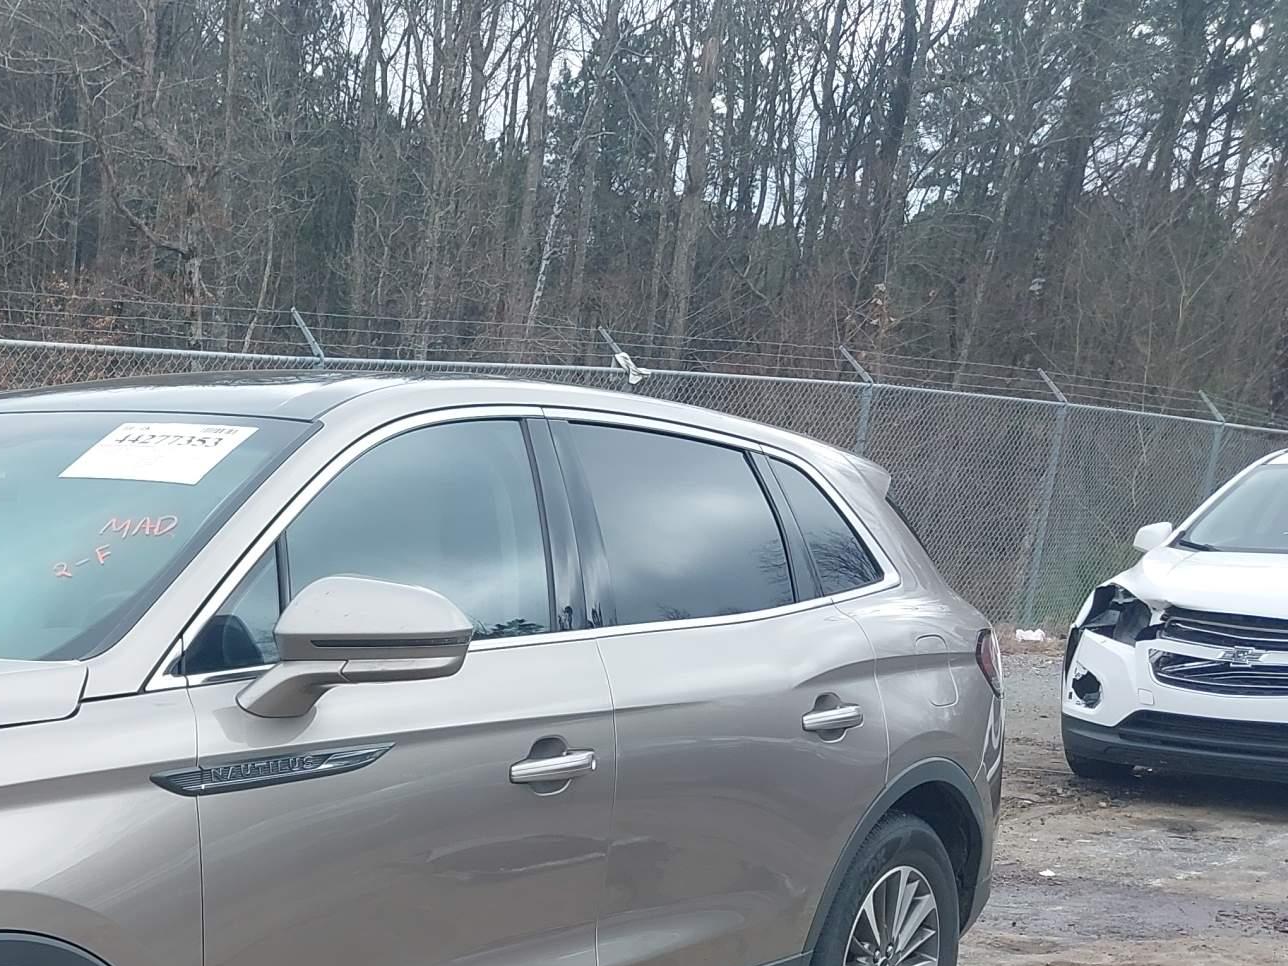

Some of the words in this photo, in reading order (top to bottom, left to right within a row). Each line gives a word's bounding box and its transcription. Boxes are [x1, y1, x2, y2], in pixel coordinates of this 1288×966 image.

[114, 433, 224, 448] 44277353
[99, 514, 179, 539] MAD
[211, 754, 315, 784] NAUTILUS
